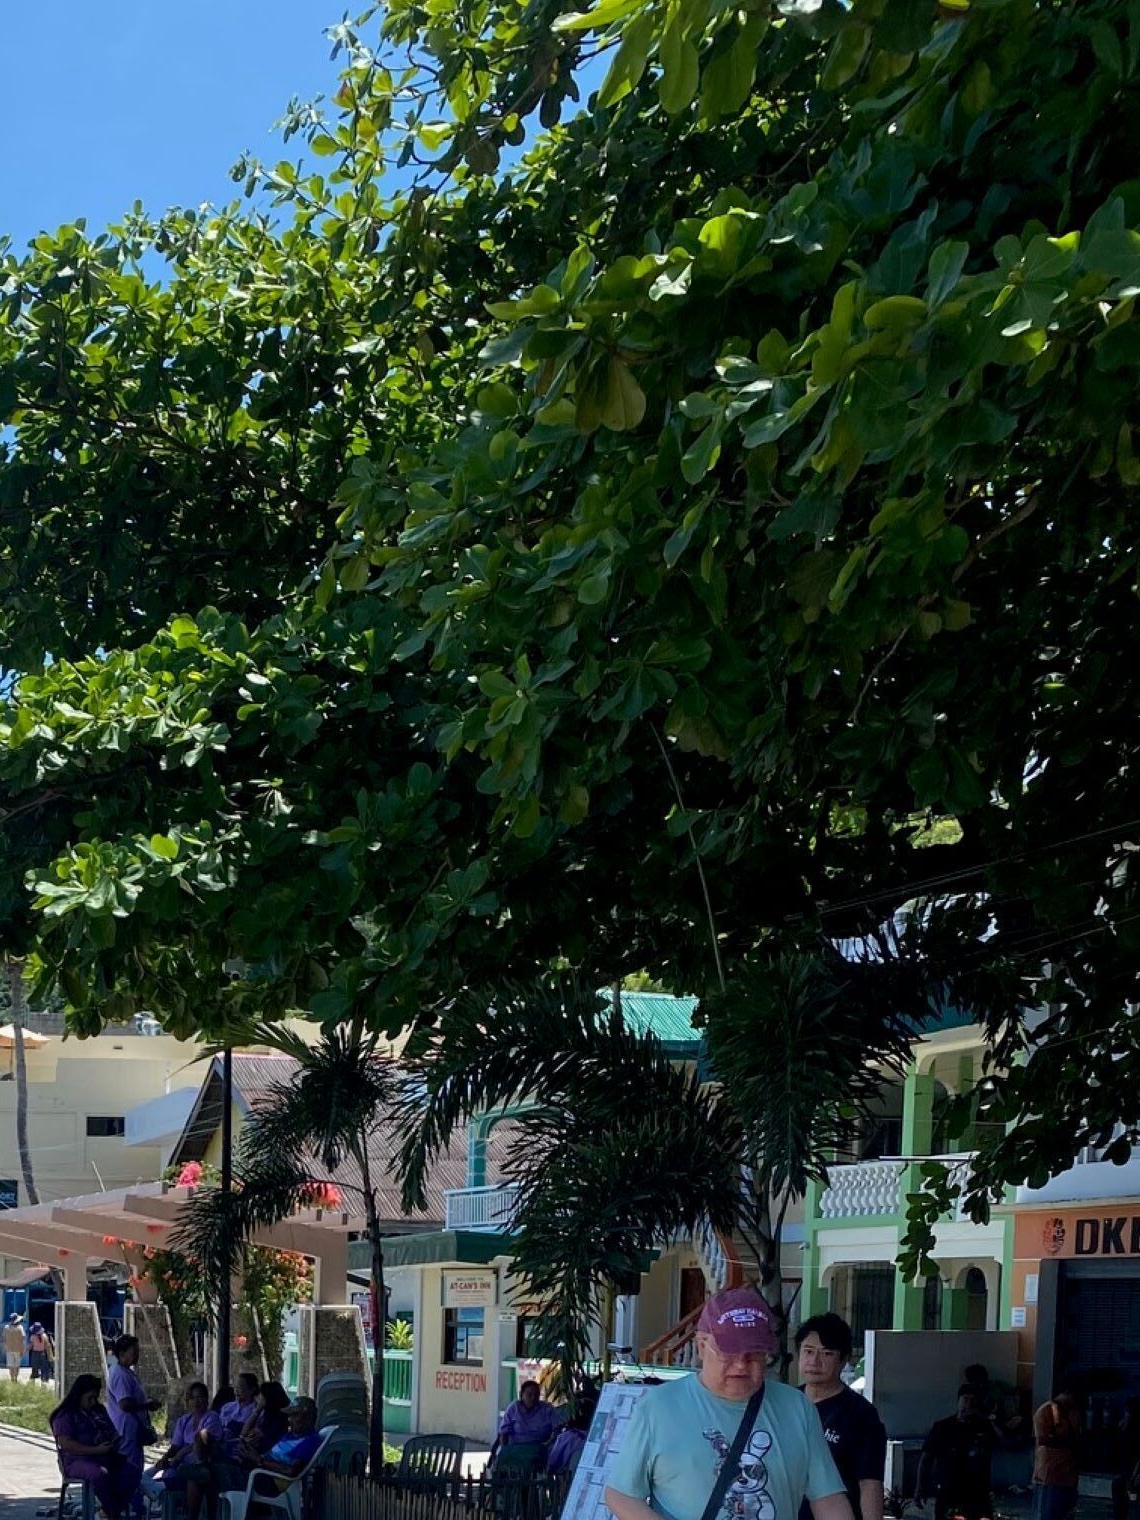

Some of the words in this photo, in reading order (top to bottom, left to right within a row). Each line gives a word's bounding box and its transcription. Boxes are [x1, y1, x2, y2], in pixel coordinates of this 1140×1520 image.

[480, 1282, 491, 1290] INN
[435, 1371, 487, 1392] RECEPTION
[825, 1428, 840, 1443] hic
